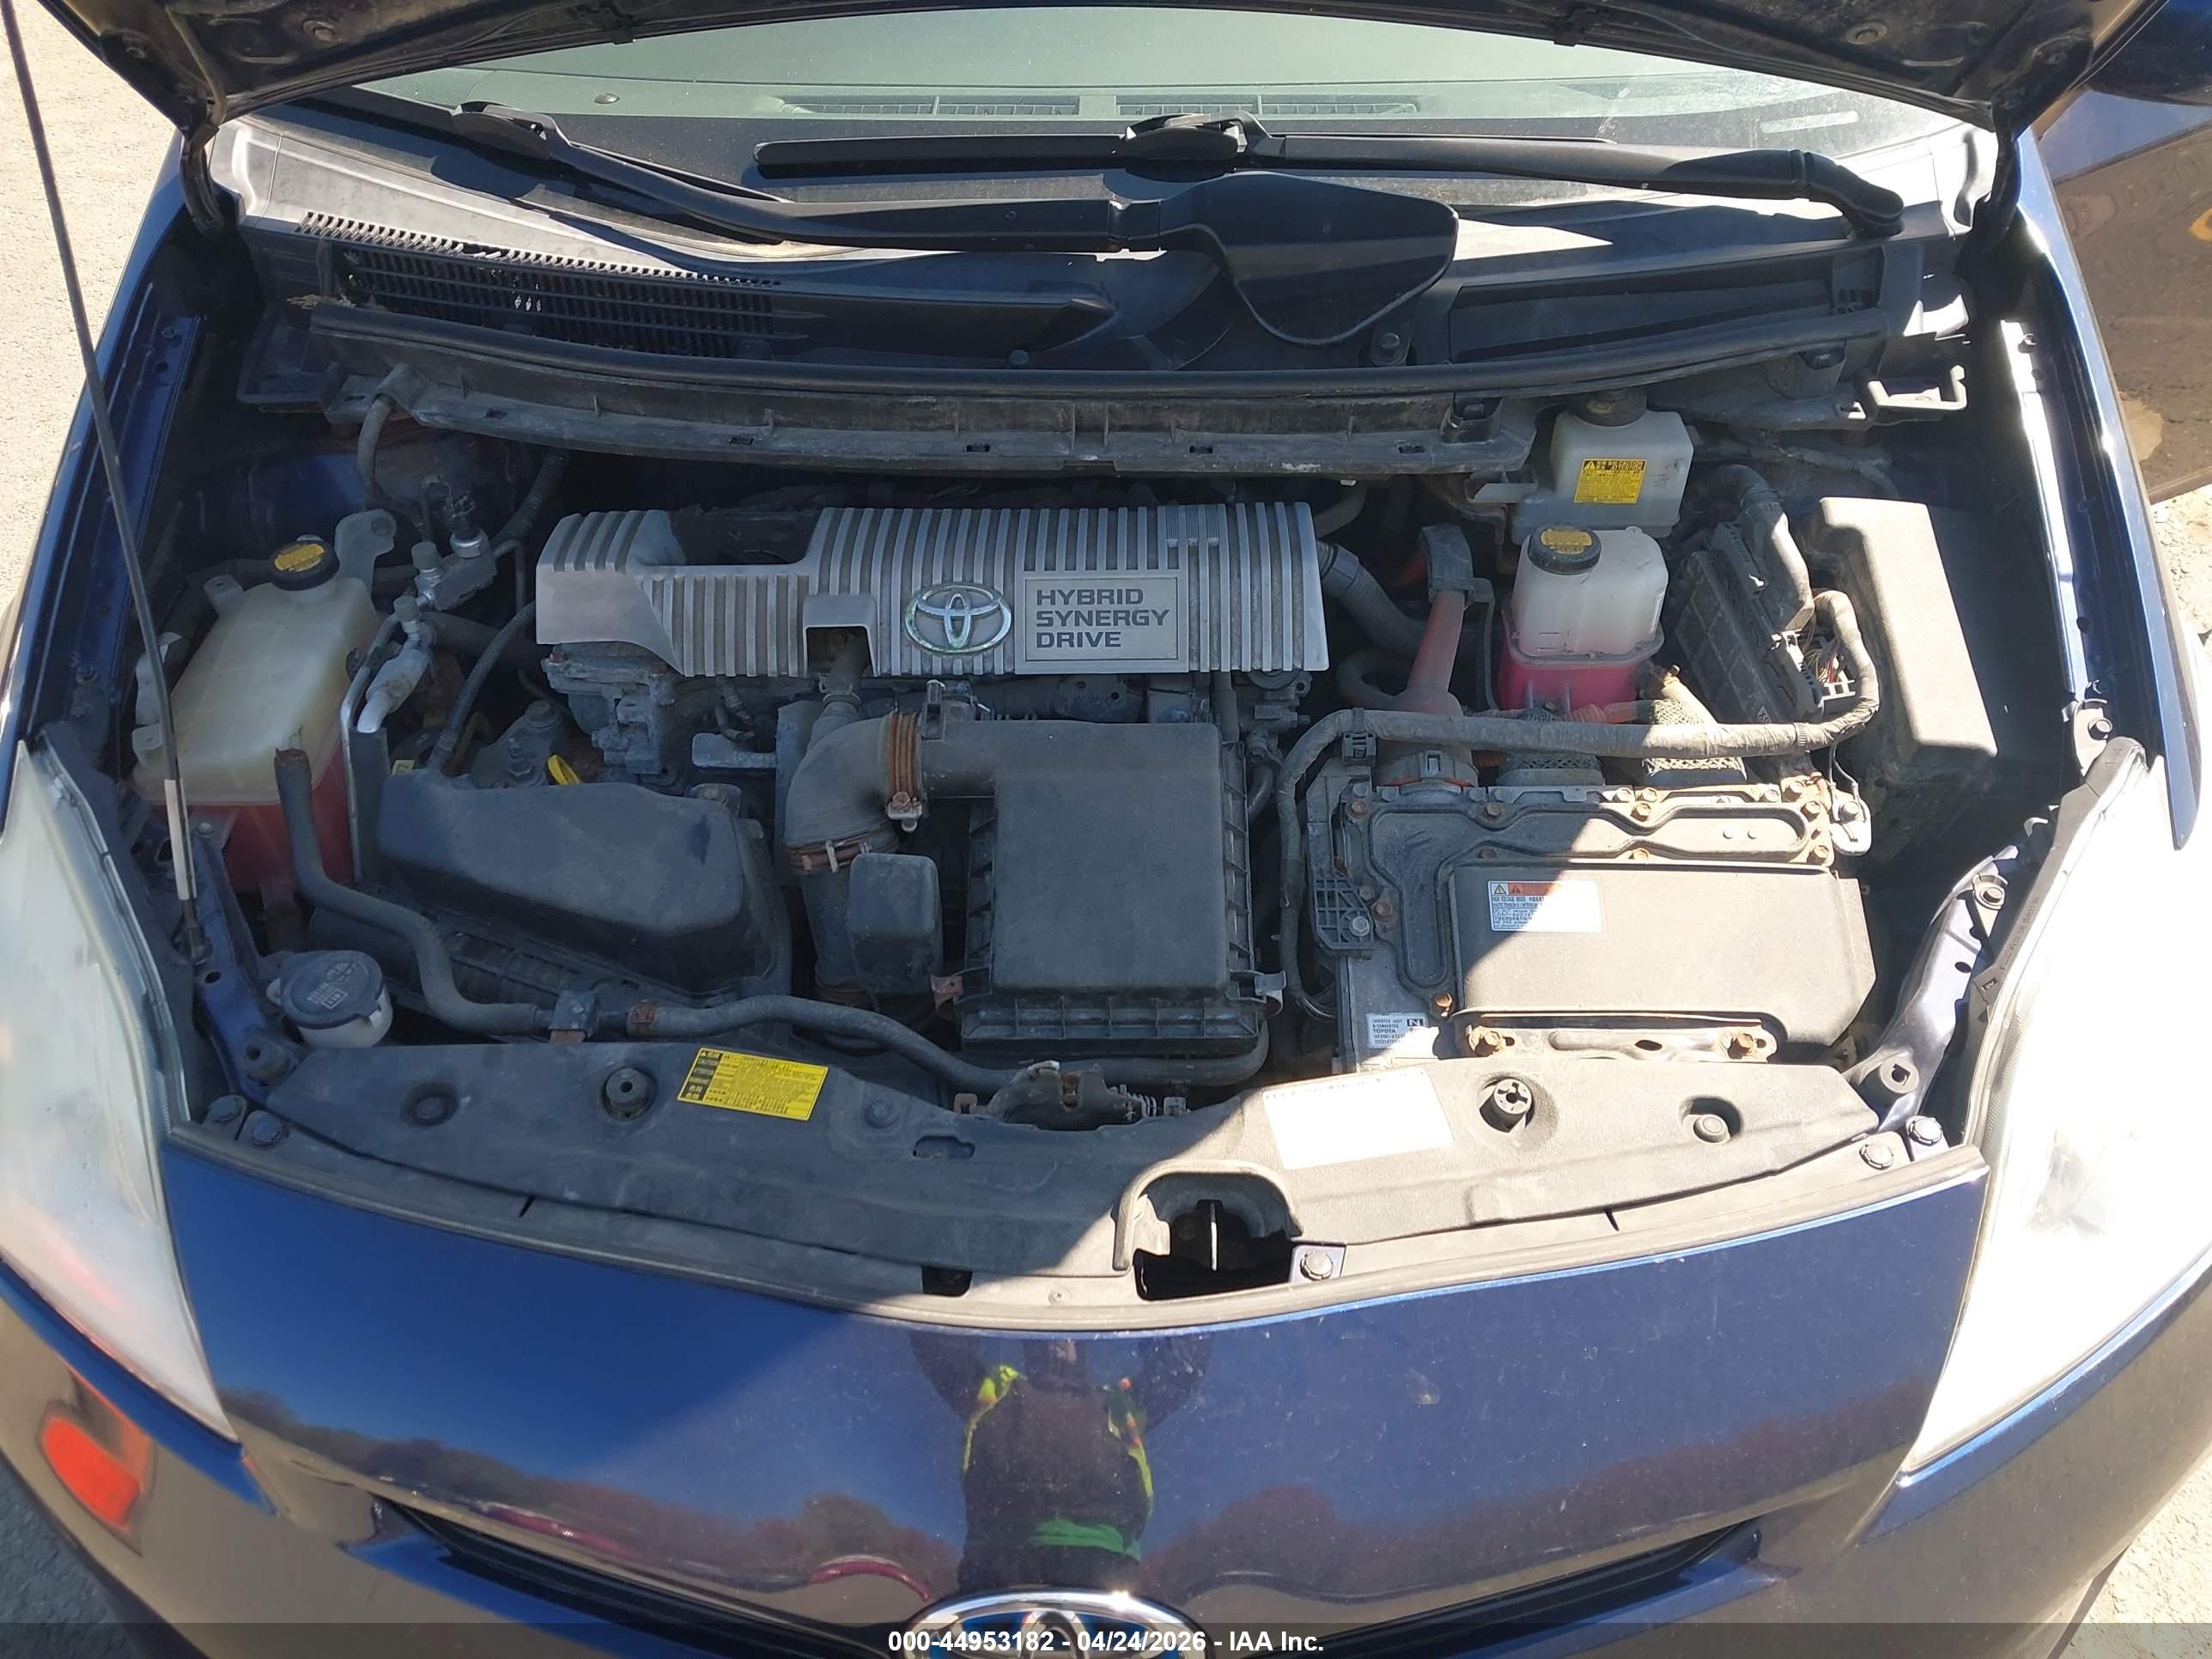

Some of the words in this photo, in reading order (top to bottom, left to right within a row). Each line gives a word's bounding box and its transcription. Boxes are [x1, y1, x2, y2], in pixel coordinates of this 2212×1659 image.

[1036, 588, 1144, 605] HYBRID
[1036, 609, 1170, 627] SYNERGY
[1036, 631, 1121, 648] DRIVE
